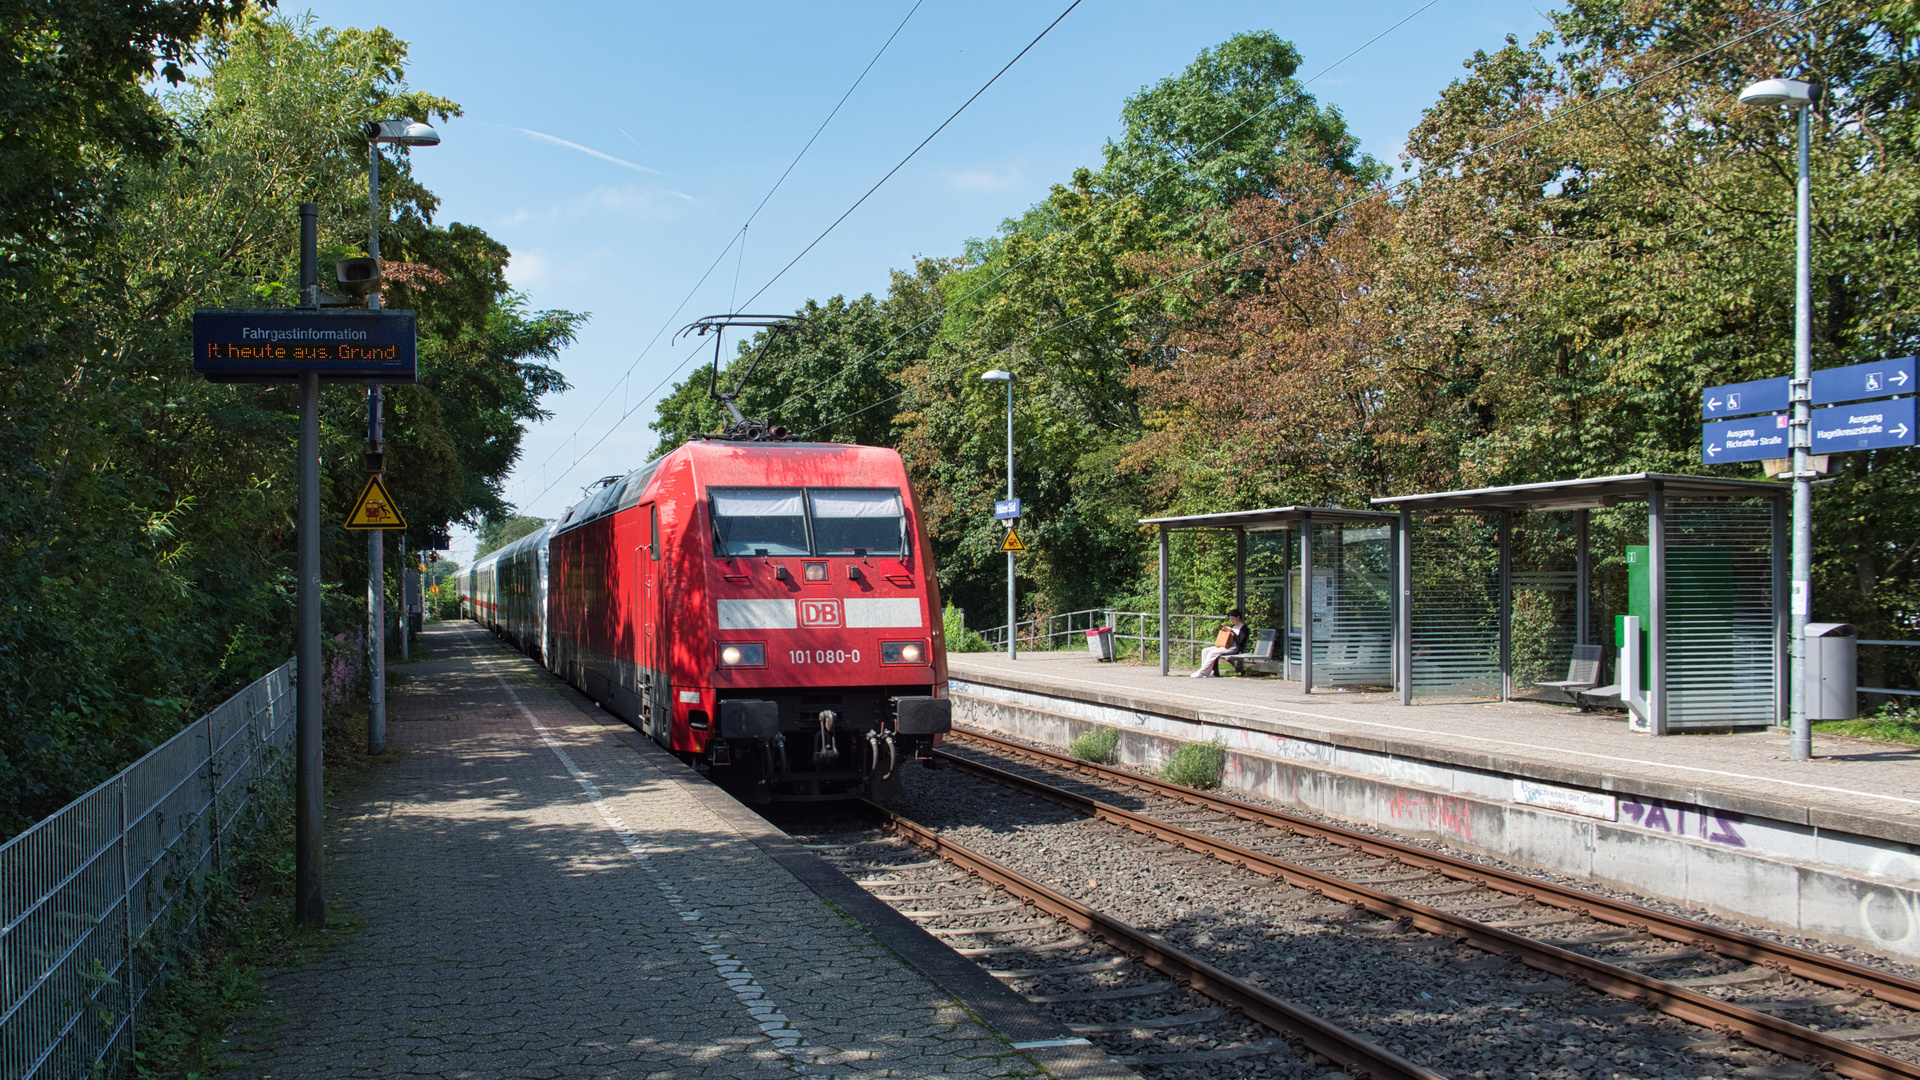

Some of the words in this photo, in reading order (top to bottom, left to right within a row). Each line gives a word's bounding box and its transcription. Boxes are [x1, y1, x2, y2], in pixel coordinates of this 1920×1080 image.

[243, 327, 367, 342] Fahrgastinformation
[228, 343, 286, 358] heute
[294, 346, 332, 359] aus.
[339, 344, 395, 359] Grund
[1849, 414, 1883, 425] Ausgang
[1726, 429, 1755, 439] Ausgang
[1817, 424, 1883, 440] Hagelkreuzstraße
[1726, 438, 1759, 449] Richrather
[1760, 436, 1782, 446] Straße
[805, 603, 836, 623] DB
[789, 650, 811, 664] 101
[816, 649, 860, 664] 080-0
[1568, 793, 1579, 802] der
[1582, 794, 1605, 806] Gleise
